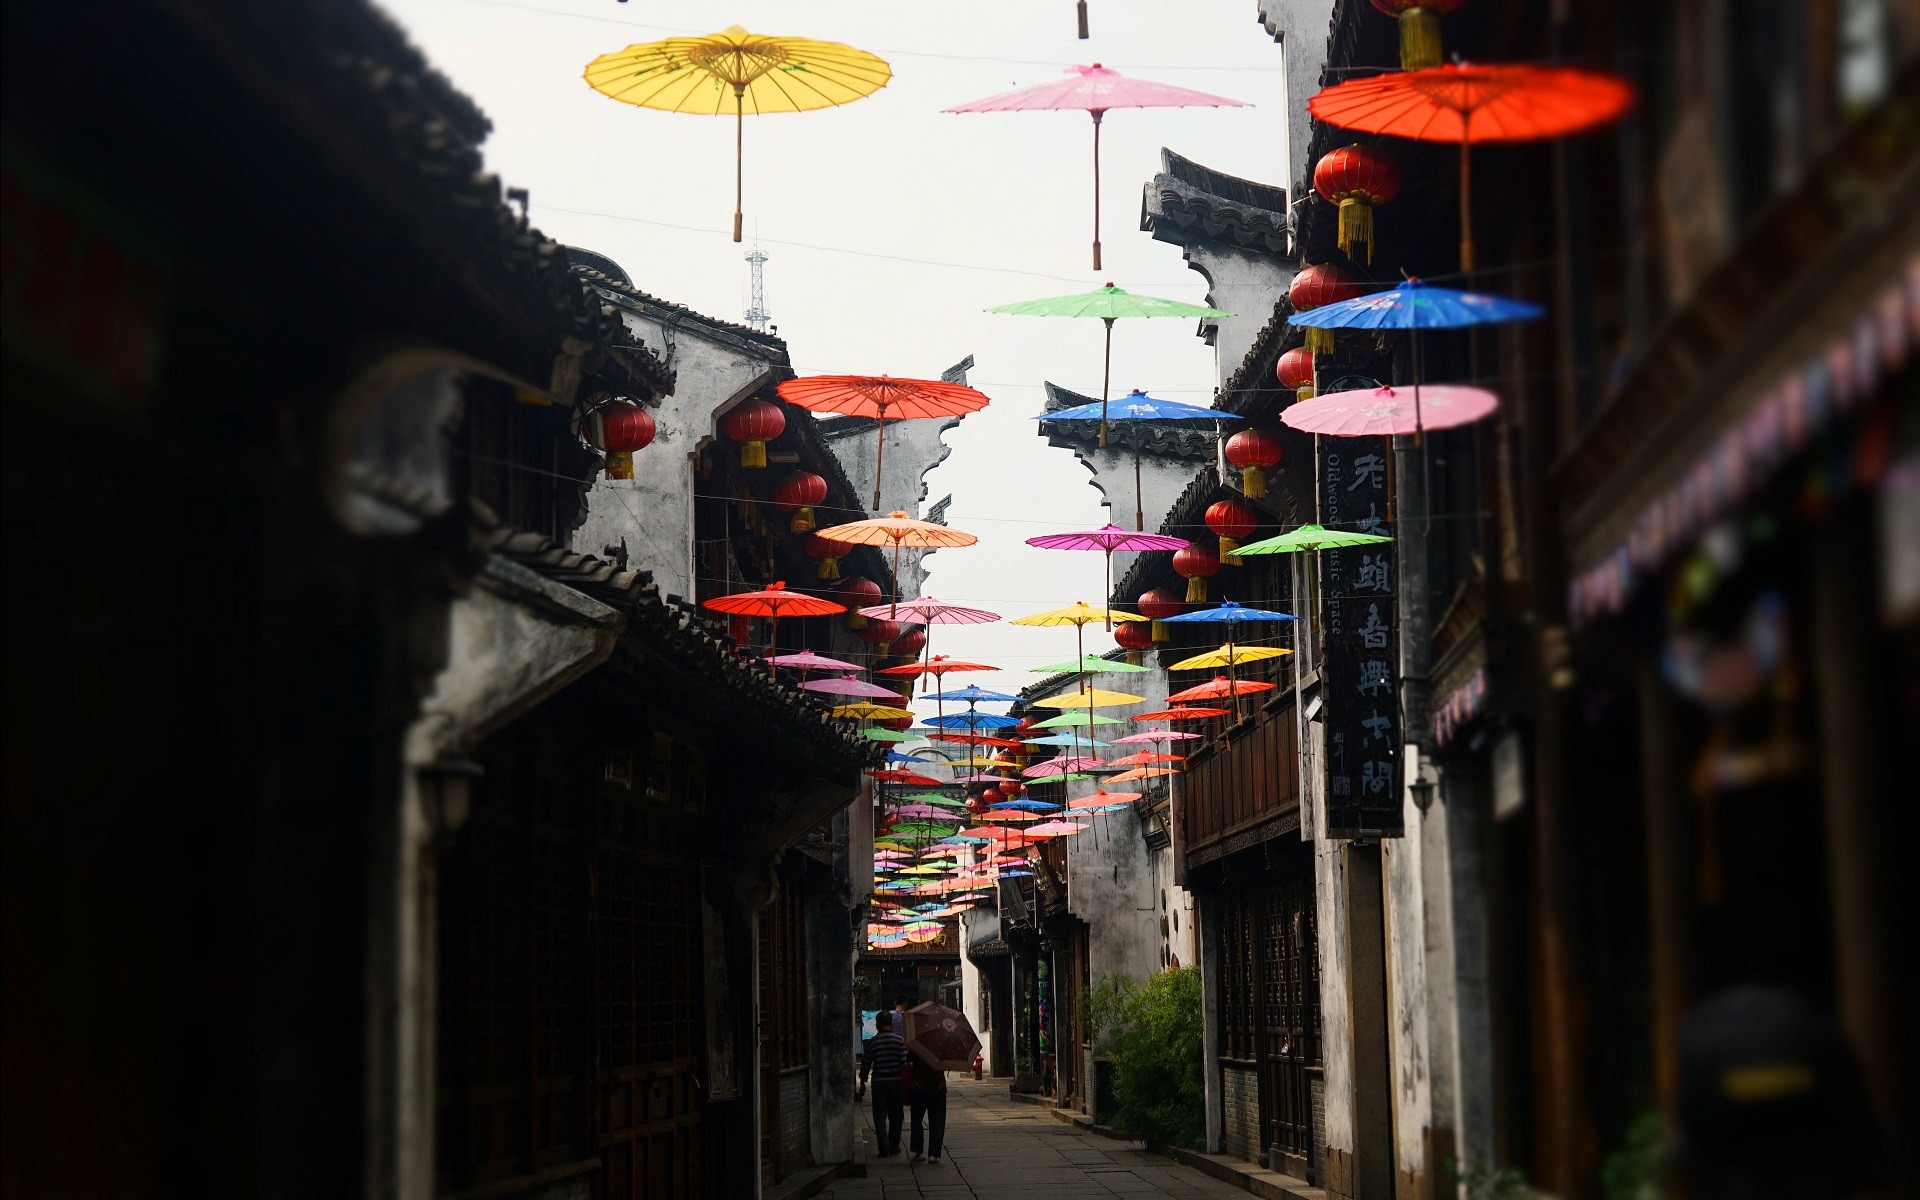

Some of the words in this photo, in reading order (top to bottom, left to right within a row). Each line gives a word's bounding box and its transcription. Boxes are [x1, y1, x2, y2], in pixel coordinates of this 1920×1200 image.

[1328, 453, 1341, 527] Oldwood
[1331, 549, 1342, 581] usic
[1328, 590, 1343, 635] Space
